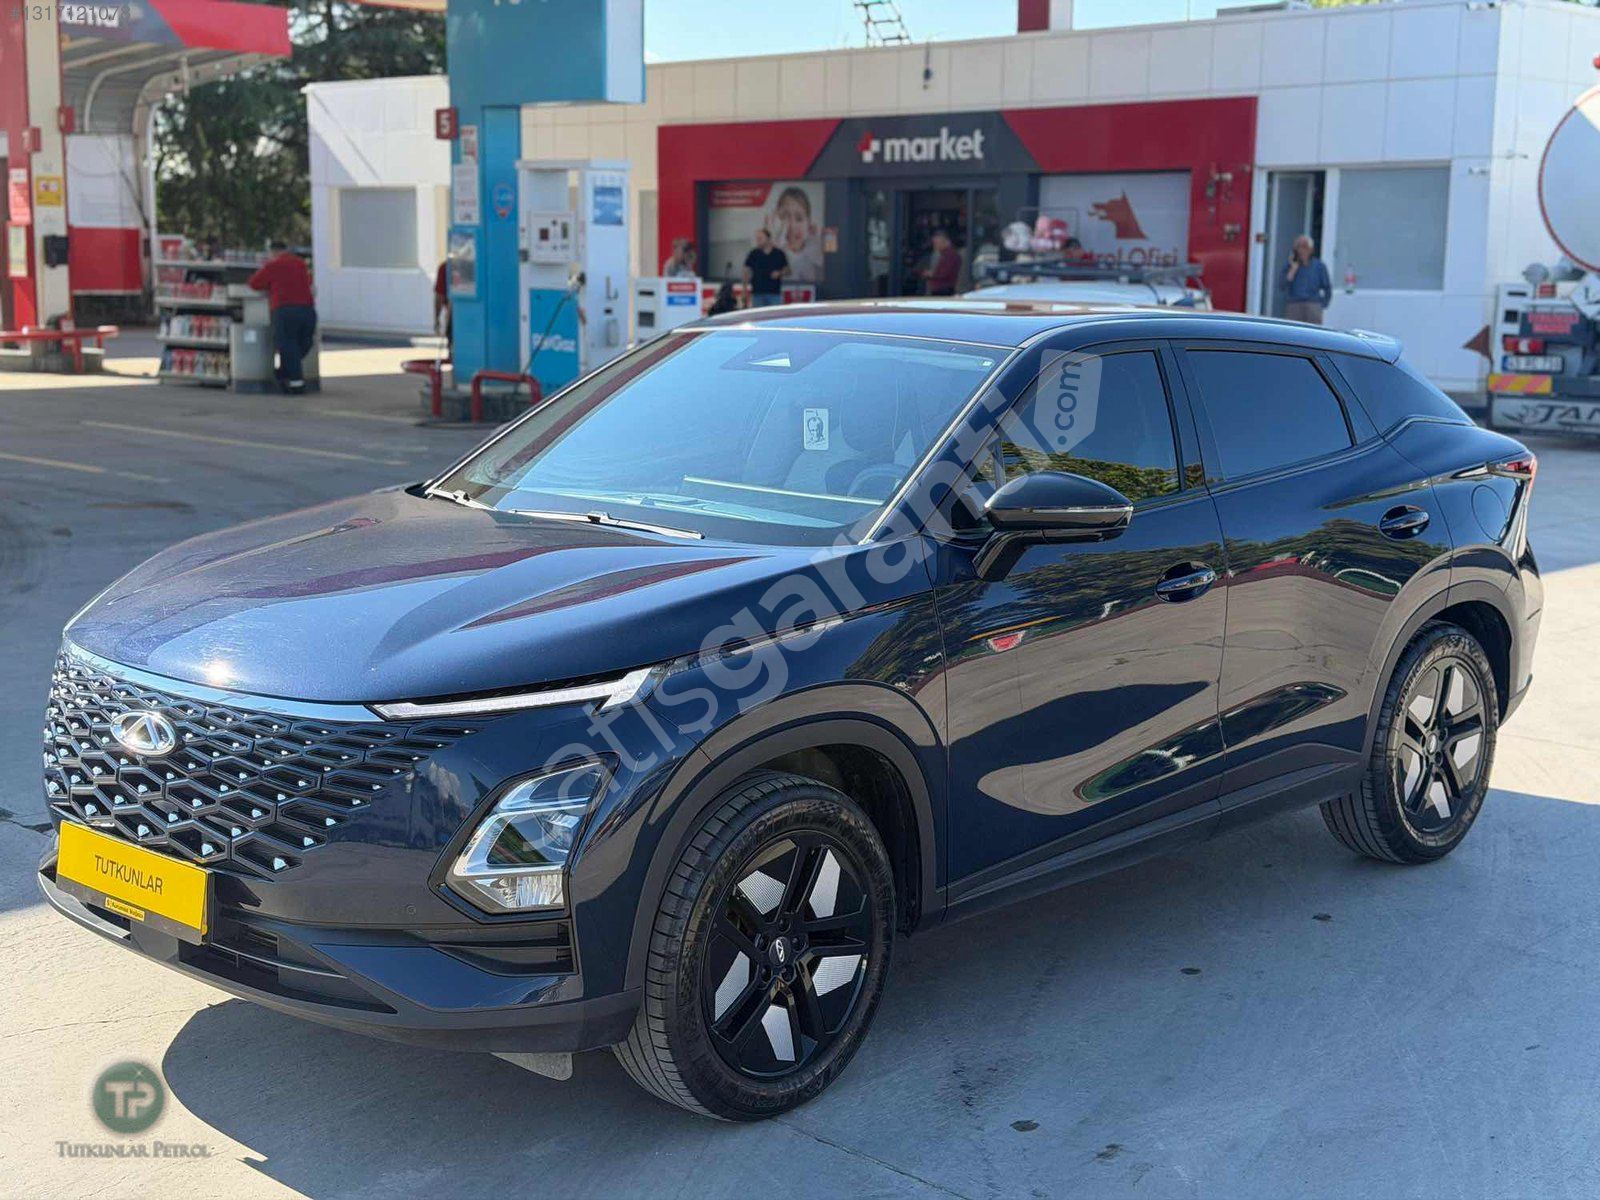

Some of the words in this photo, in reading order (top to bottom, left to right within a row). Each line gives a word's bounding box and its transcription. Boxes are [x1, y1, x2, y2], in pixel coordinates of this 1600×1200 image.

[438, 112, 451, 136] 5
[884, 126, 985, 162] market
[94, 853, 164, 896] TUTKUNLAR
